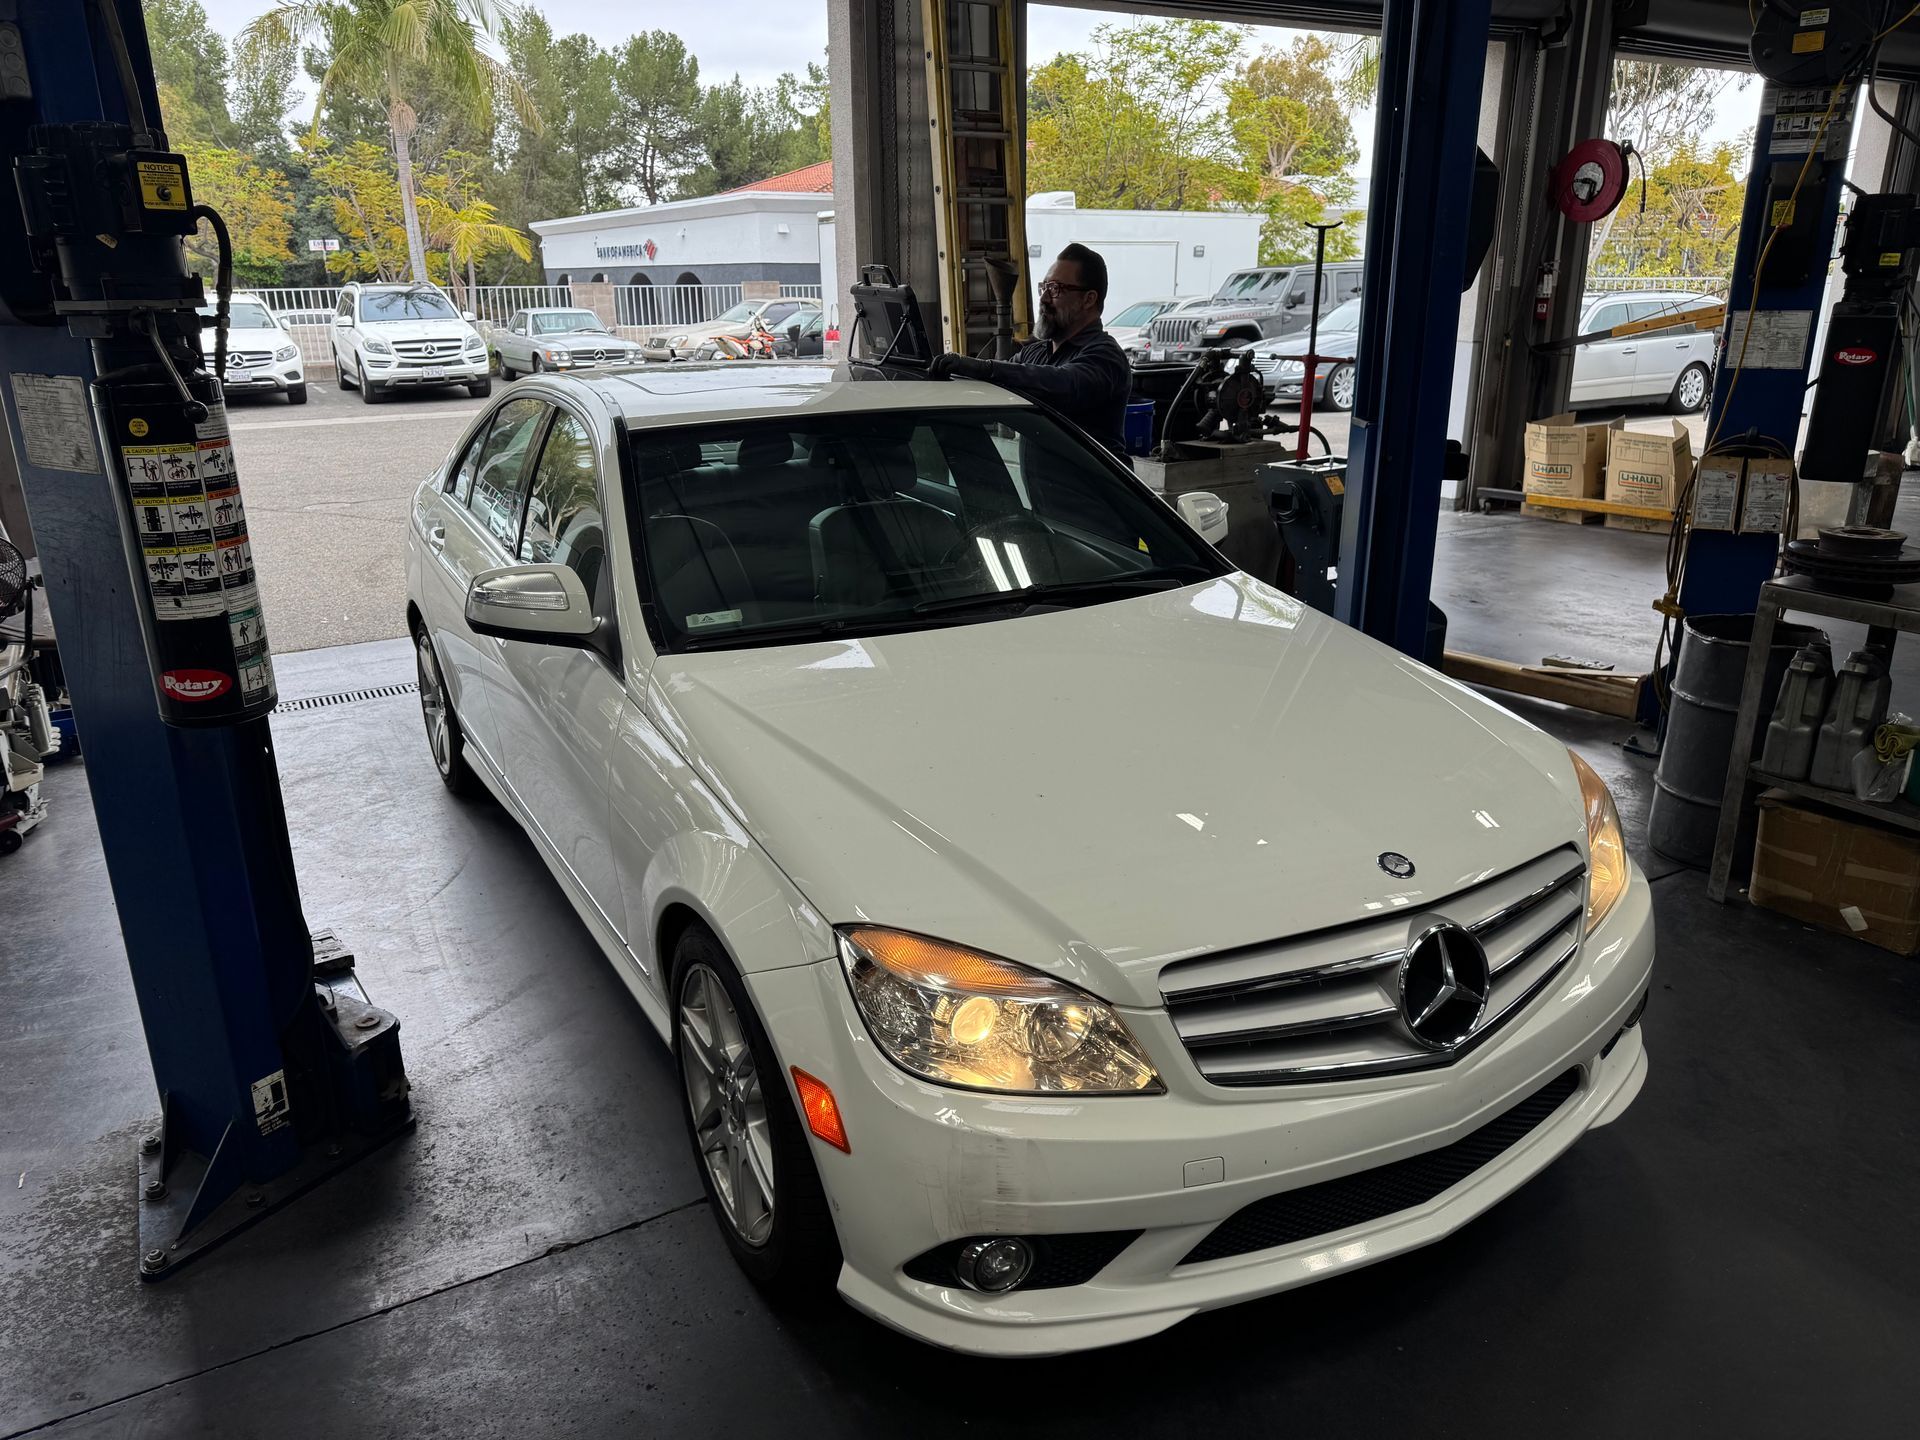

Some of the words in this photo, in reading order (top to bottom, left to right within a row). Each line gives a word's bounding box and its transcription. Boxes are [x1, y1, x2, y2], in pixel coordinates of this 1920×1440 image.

[144, 164, 174, 172] NOTICE
[1839, 352, 1872, 364] Rotary
[1533, 463, 1569, 474] U-HAUL
[1621, 473, 1660, 484] U-HAUL
[164, 676, 222, 696] Rotary
